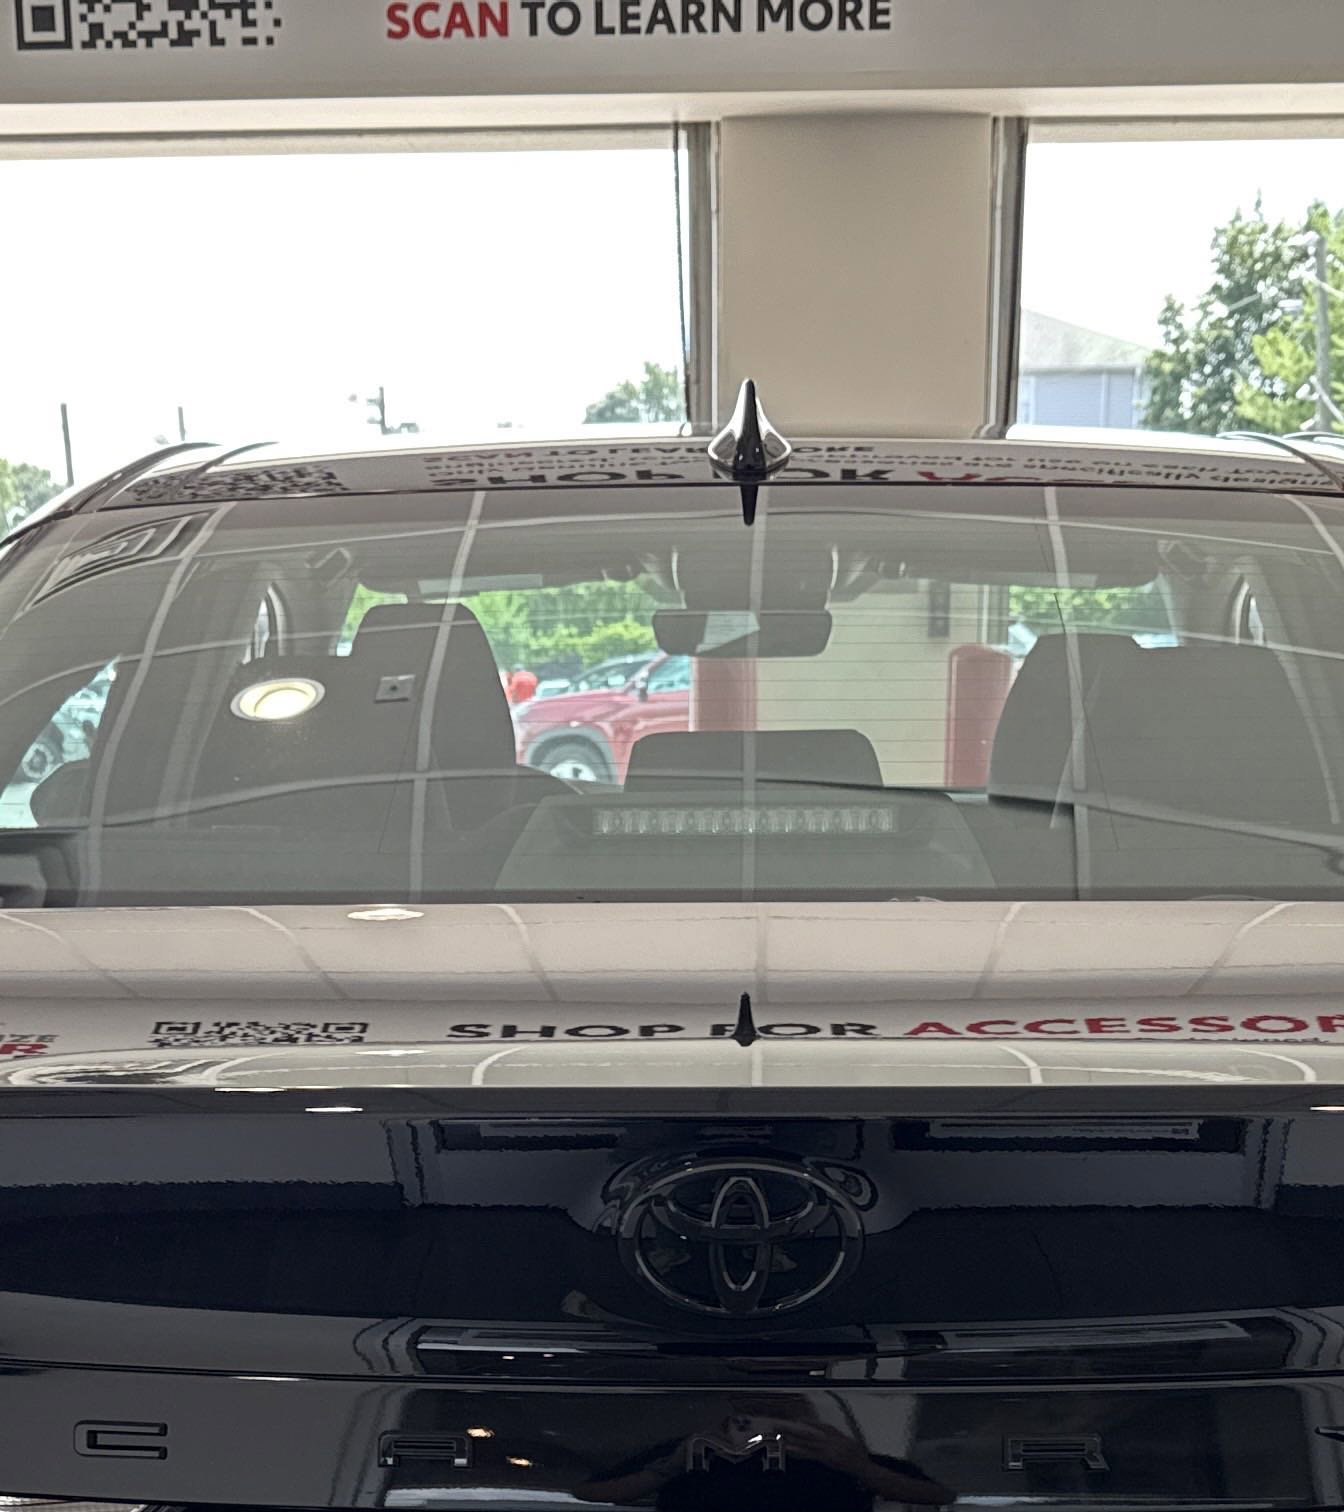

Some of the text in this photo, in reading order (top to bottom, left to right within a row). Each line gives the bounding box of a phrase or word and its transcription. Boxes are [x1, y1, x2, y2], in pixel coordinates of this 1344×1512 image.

[386, 0, 892, 39] SCAN TO LEARN MORE
[446, 1023, 685, 1039] SHOP
